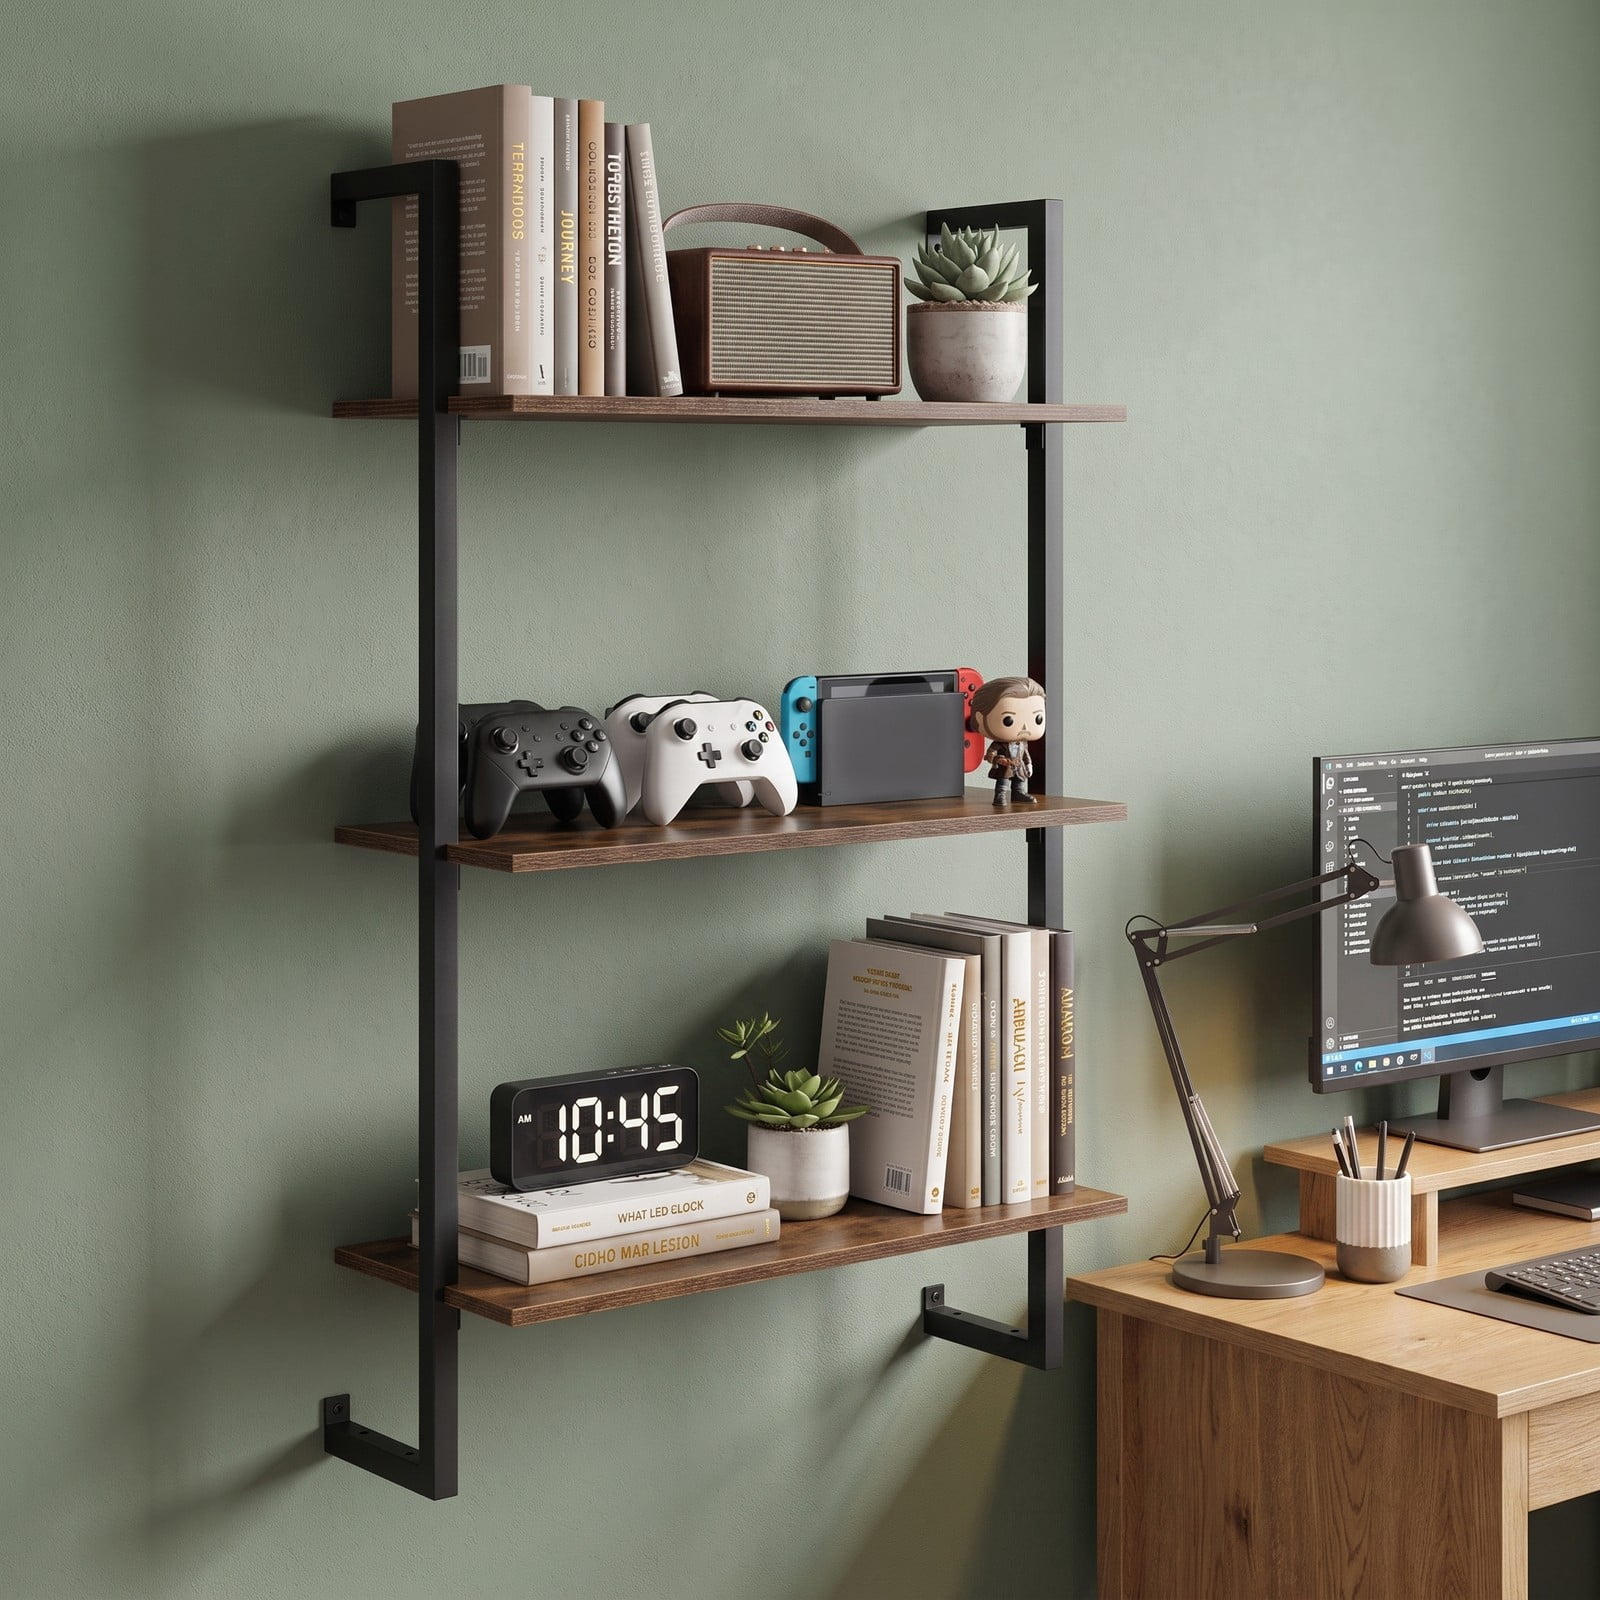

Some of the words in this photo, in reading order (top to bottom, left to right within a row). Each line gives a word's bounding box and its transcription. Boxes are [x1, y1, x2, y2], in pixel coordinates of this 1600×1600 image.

[560, 210, 575, 285] JOURNEY
[517, 1114, 532, 1124] AM
[557, 1085, 683, 1164] 10:45
[617, 1209, 647, 1224] WHAT
[649, 1206, 669, 1218] LED
[574, 1248, 616, 1269] CIDHO
[621, 1242, 650, 1260] MAR
[653, 1233, 700, 1255] LESION
